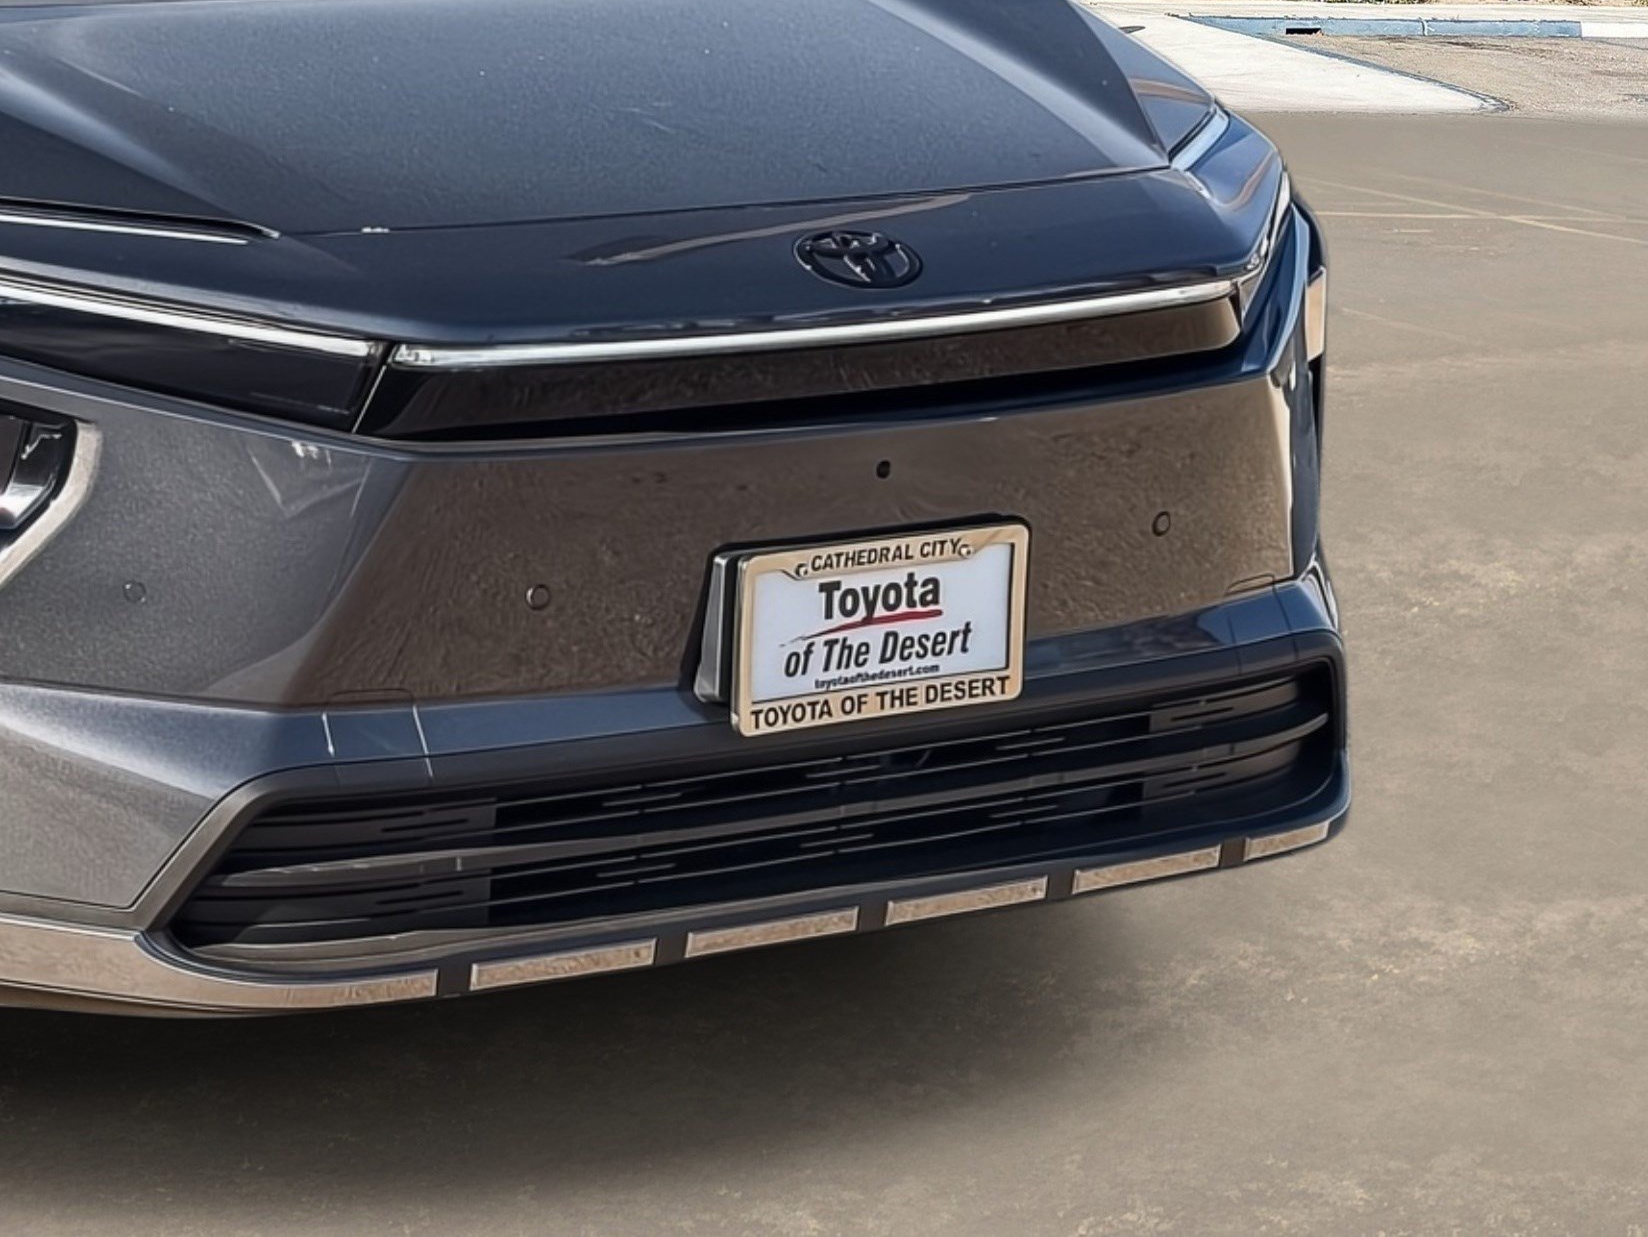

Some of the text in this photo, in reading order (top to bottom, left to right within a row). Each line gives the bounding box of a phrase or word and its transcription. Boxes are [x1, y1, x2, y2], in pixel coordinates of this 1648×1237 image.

[811, 538, 962, 572] CATHEDRAL CITY
[818, 573, 940, 621] Toyota
[784, 622, 972, 677] of The Desert
[751, 676, 1010, 729] TOYOTA OF THE DESERT
